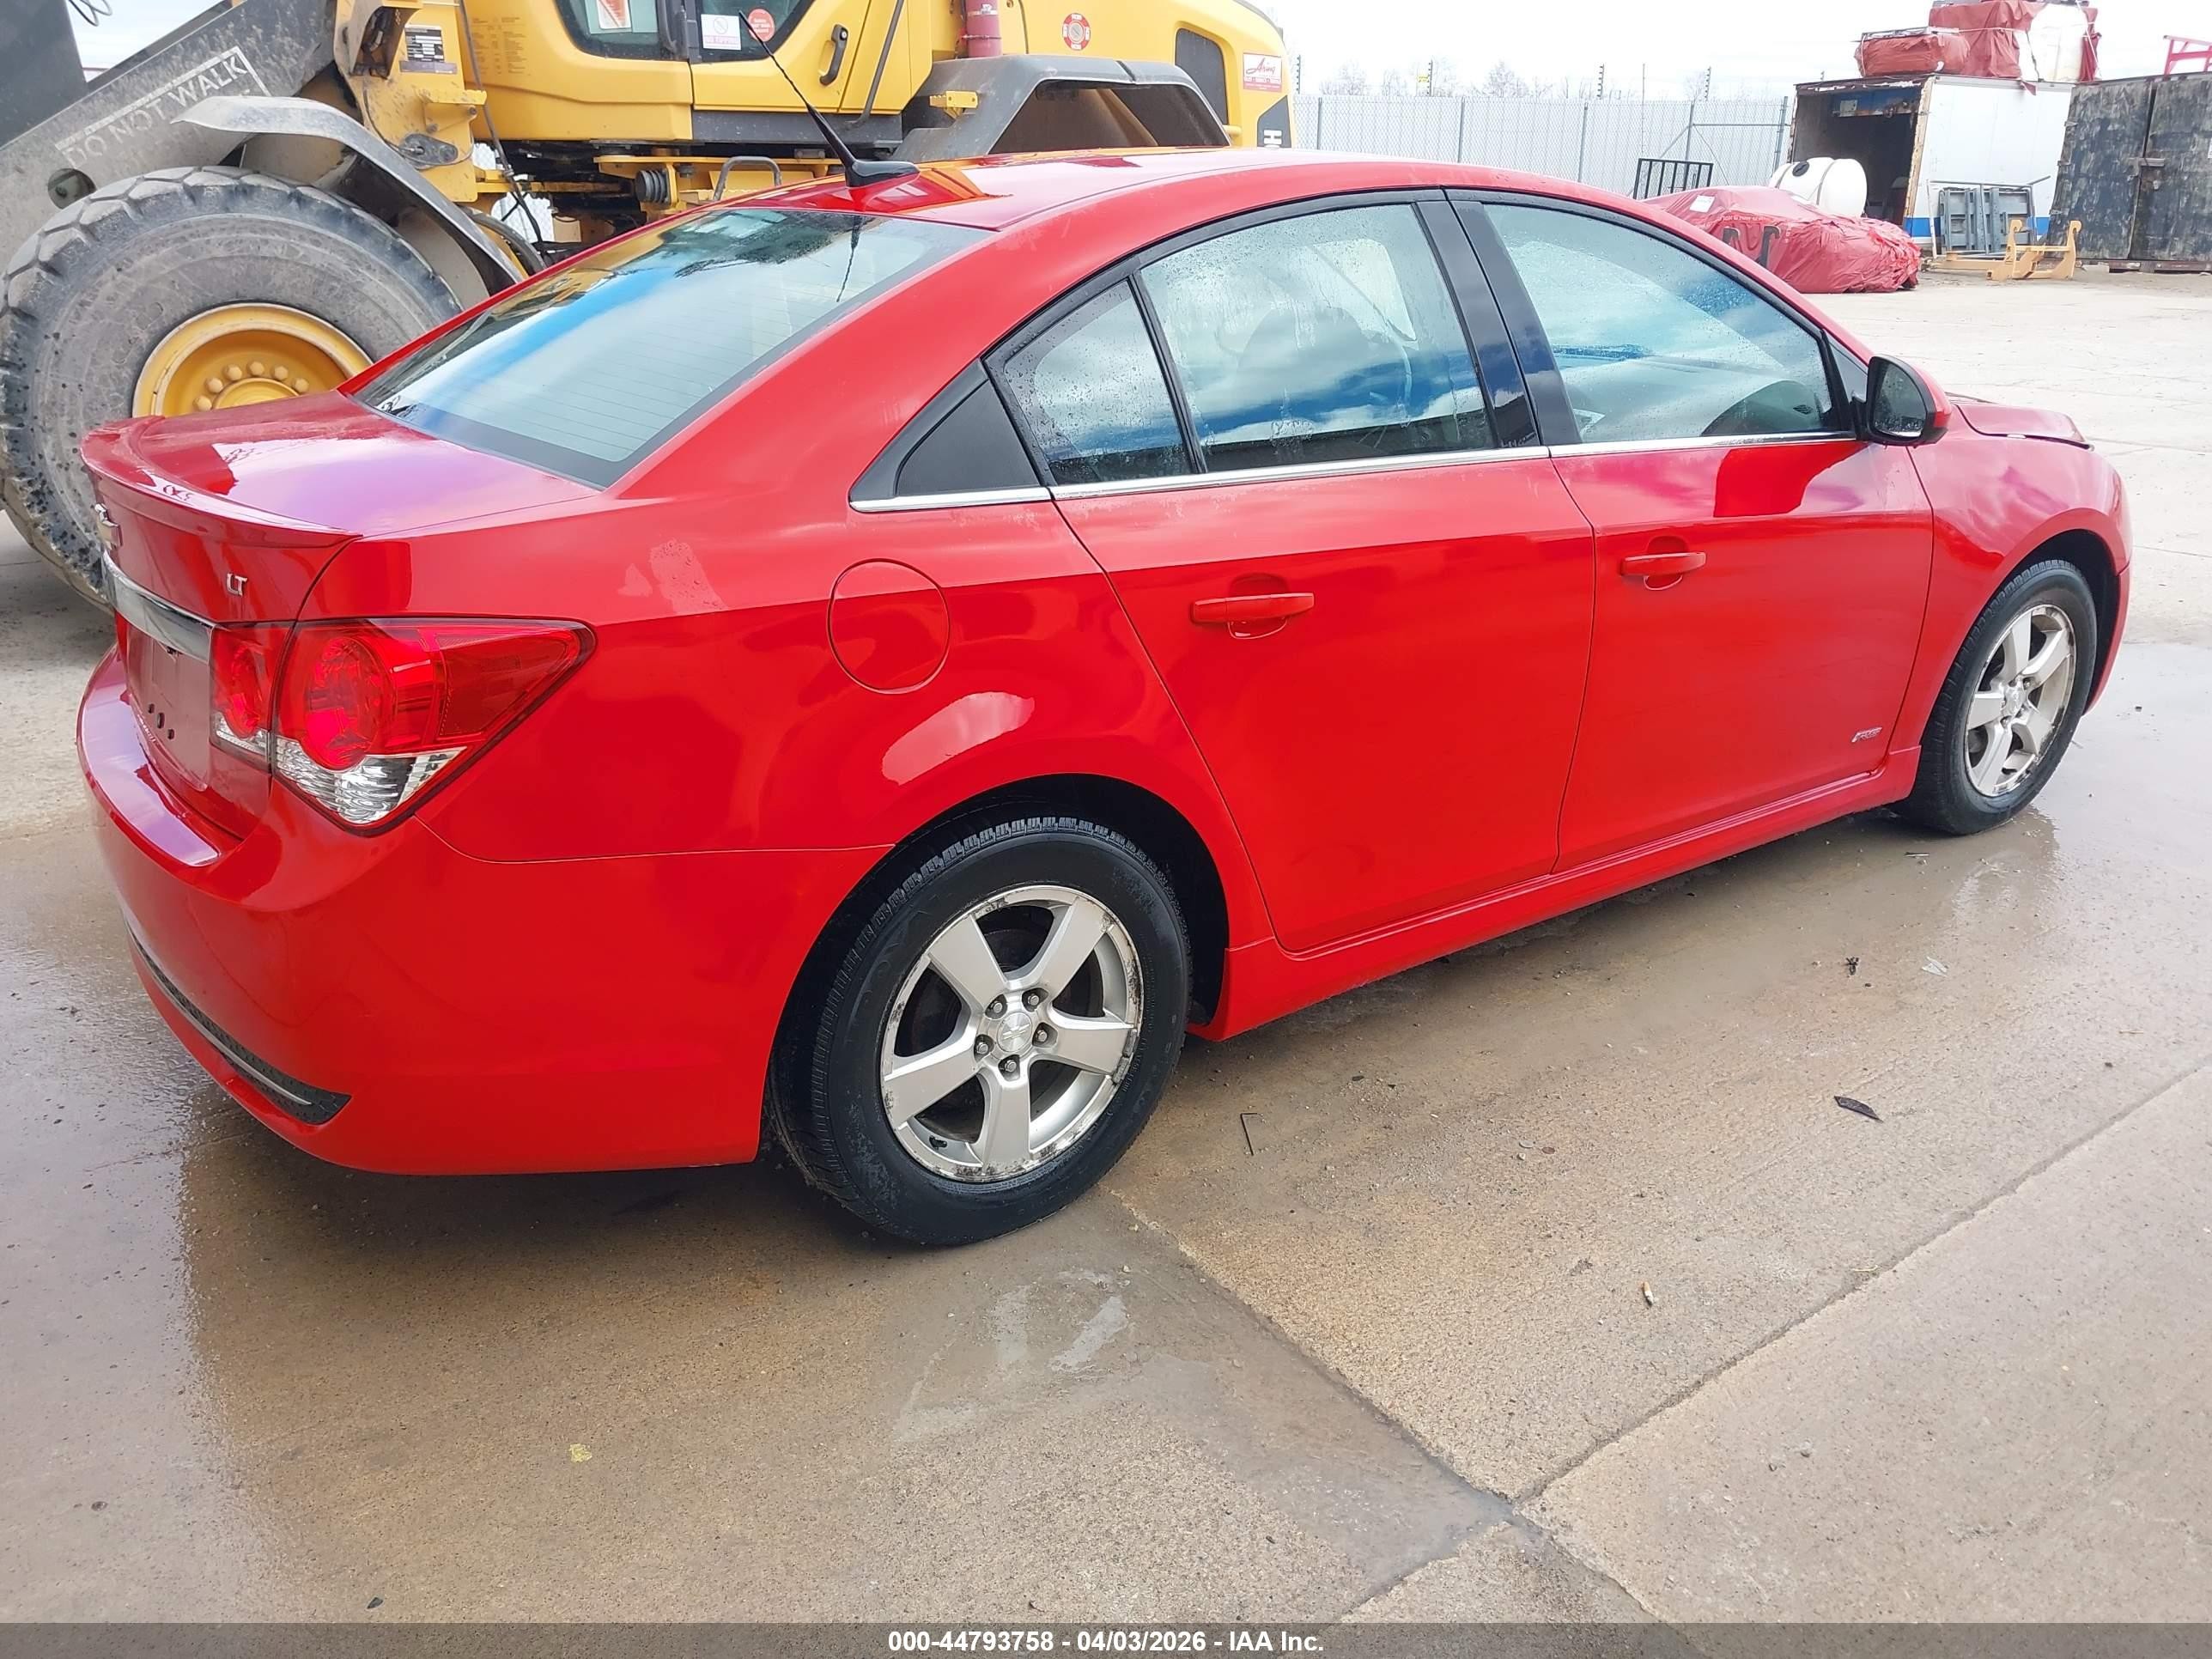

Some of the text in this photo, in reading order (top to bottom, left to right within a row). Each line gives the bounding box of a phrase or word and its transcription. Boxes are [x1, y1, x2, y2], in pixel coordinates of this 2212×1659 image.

[64, 134, 107, 169] DO
[107, 98, 167, 144] NOT
[167, 55, 248, 108] WALK
[226, 573, 248, 597] LT
